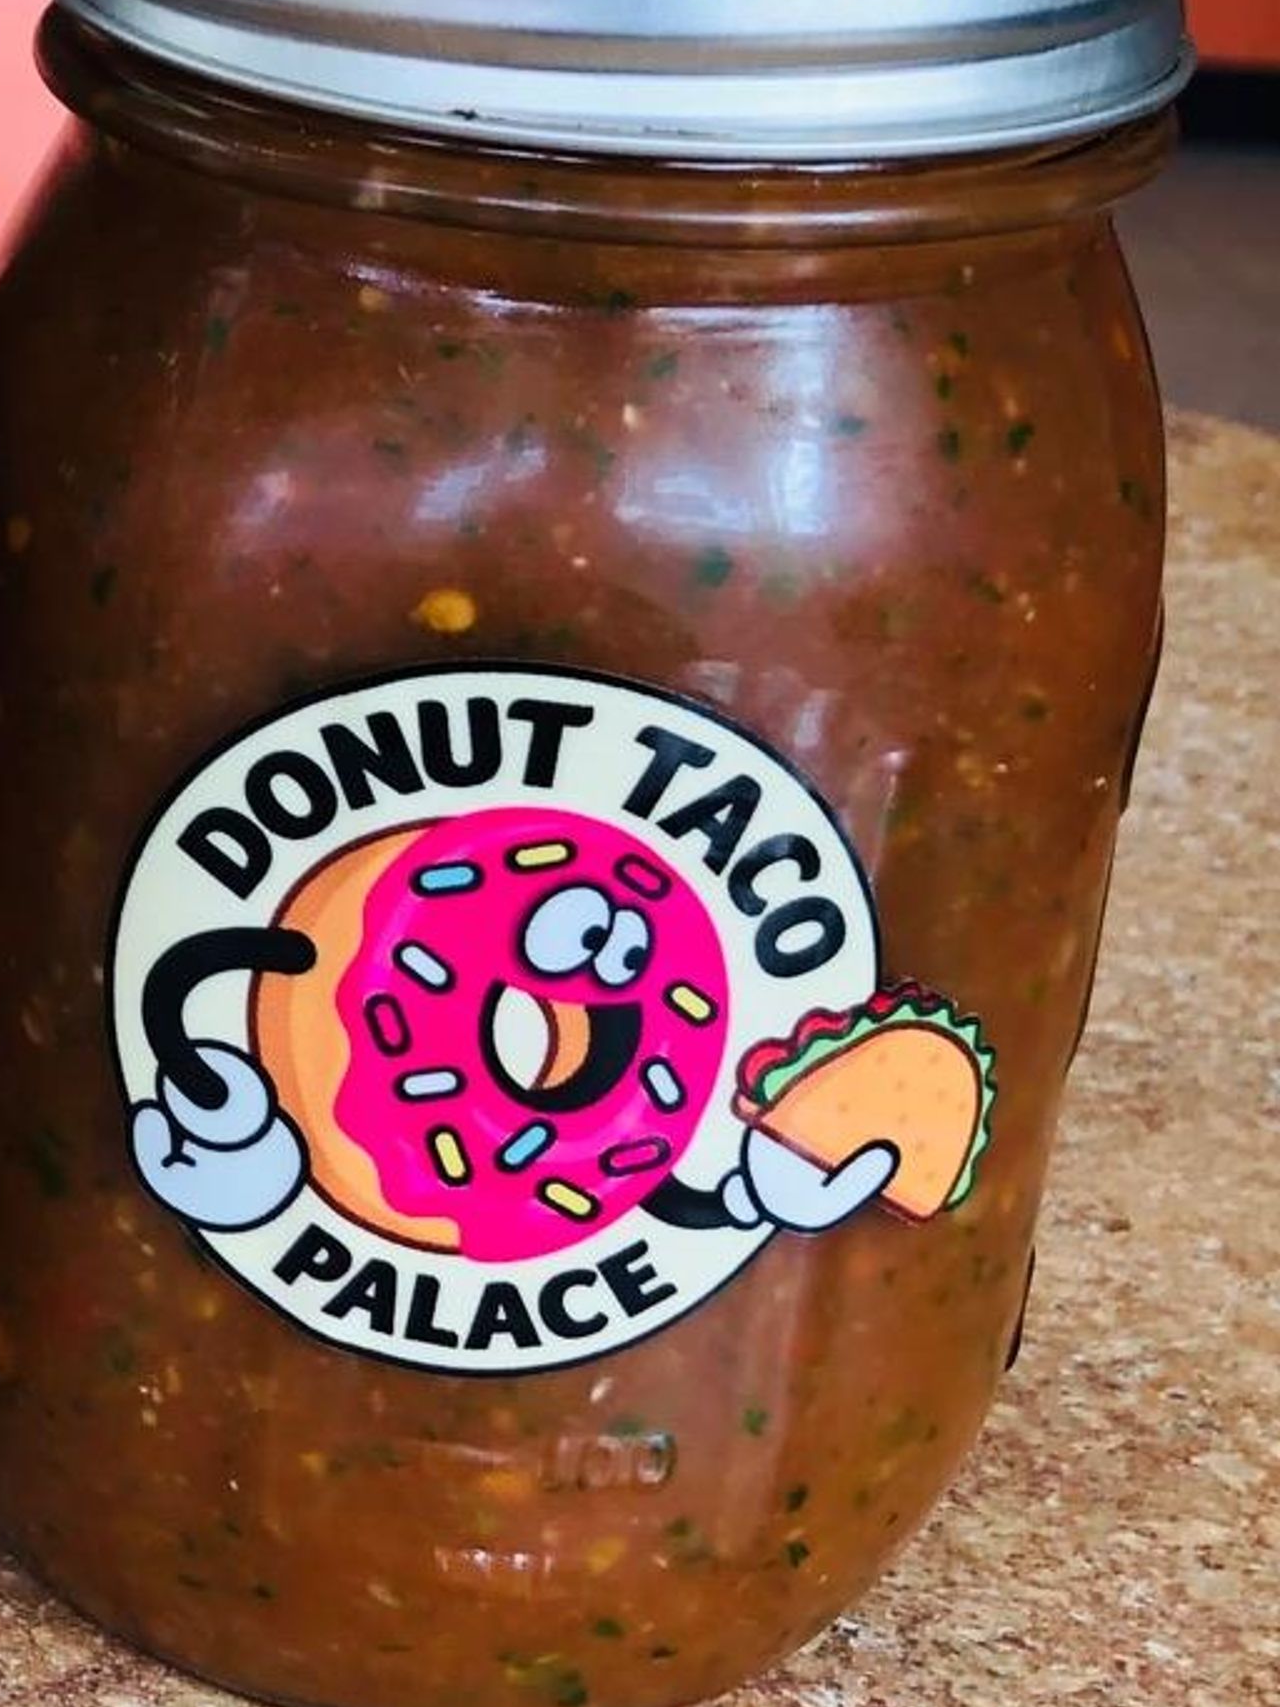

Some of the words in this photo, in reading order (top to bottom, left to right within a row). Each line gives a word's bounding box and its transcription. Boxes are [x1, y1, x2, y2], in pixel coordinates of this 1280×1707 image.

[176, 697, 594, 898] DONUT
[620, 725, 846, 979] TACO
[273, 1224, 677, 1350] PALACE
